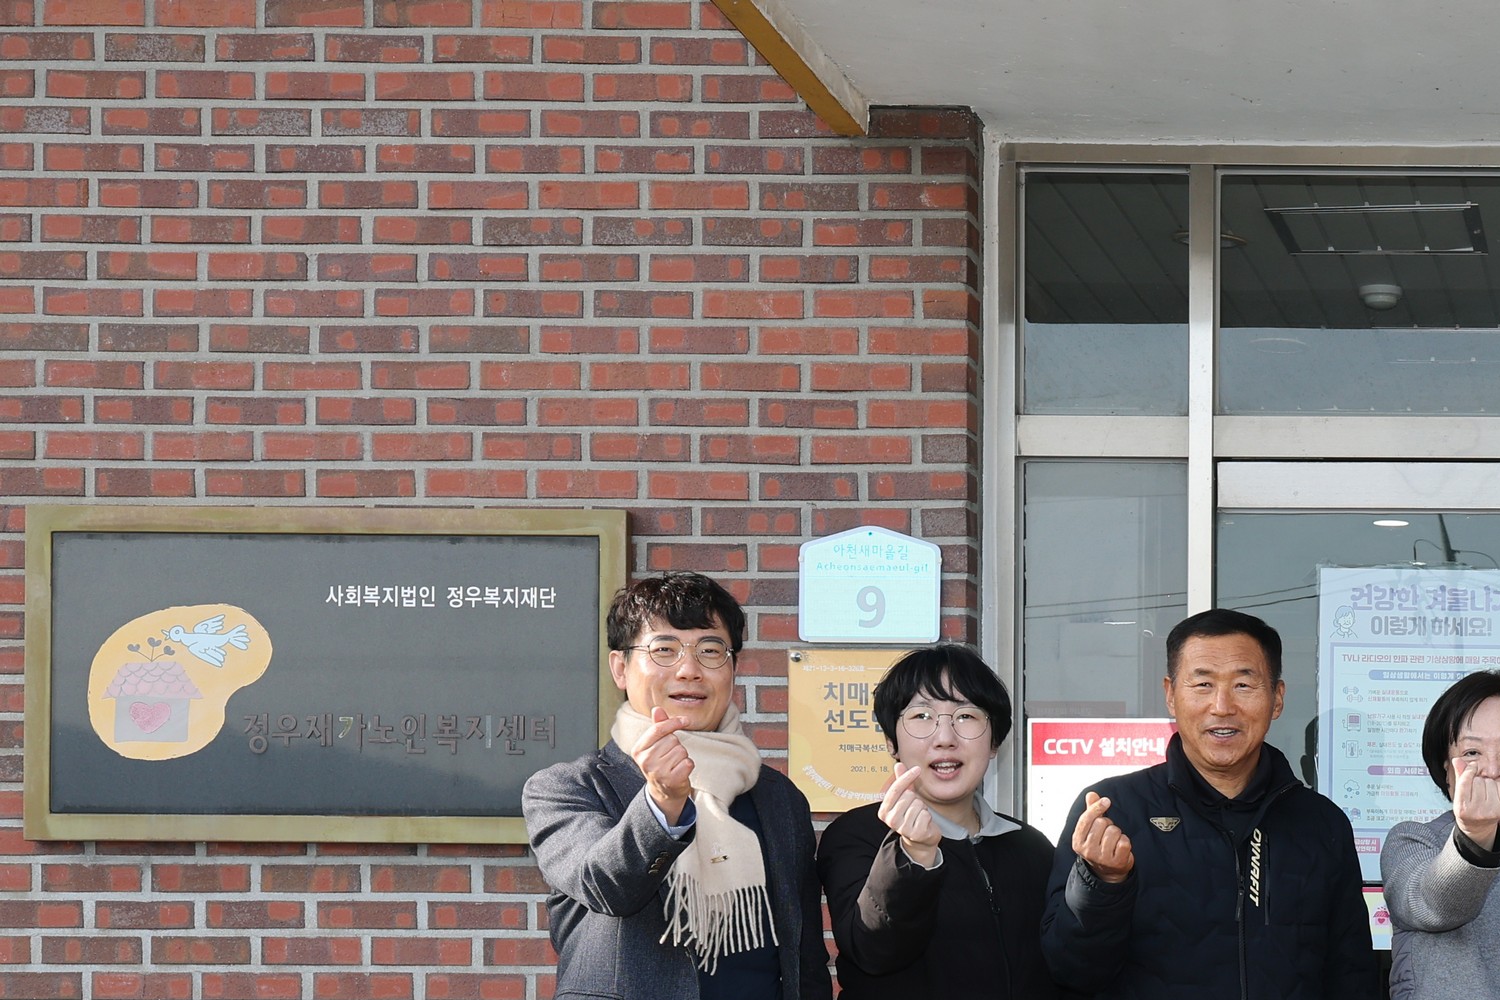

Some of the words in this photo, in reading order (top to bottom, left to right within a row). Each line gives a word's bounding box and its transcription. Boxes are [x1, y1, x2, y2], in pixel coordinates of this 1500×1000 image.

[833, 543, 909, 561] 아천새마을길
[325, 585, 437, 608] 사회복지법인
[446, 585, 557, 609] 정우복지재단
[856, 585, 886, 629] 9
[1350, 583, 1420, 612] 건강한
[1370, 616, 1427, 637] 이렇게
[1430, 616, 1492, 637] 하세요!
[1342, 654, 1360, 663] TV나
[1361, 654, 1392, 663] 라디오의
[1409, 655, 1425, 664] 관련
[243, 712, 557, 755] 정우재가노인복지센터
[1043, 738, 1094, 755] CCTV
[1098, 736, 1166, 757] 설치안내
[850, 765, 869, 773] 2021.
[870, 765, 877, 773] 6.
[879, 765, 890, 773] 18.
[1249, 827, 1262, 907] DYNAFIT
